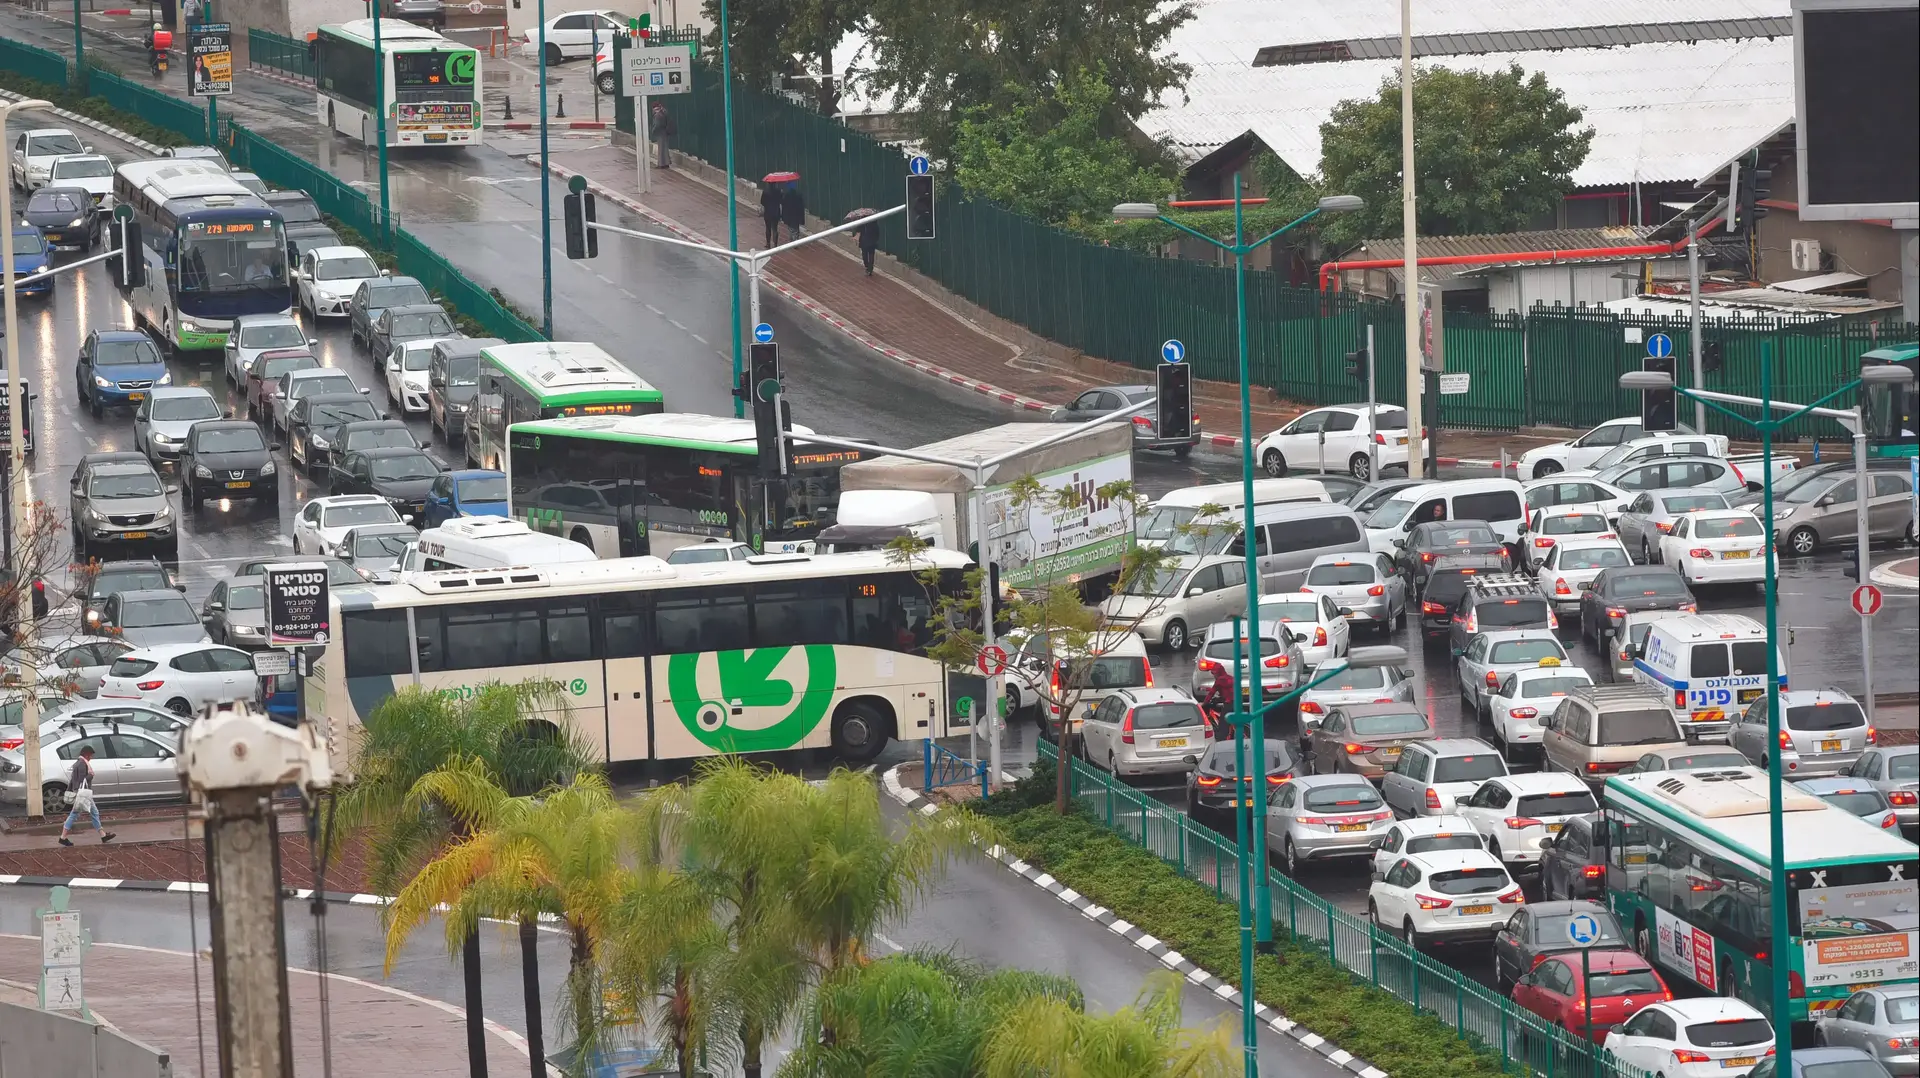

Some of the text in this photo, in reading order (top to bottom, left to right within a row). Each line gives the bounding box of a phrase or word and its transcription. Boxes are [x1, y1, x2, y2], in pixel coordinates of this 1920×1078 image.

[201, 36, 222, 45] הביתה
[630, 56, 681, 68] מיון בילינסון
[207, 224, 223, 234] 279
[430, 542, 446, 558] TOUR
[274, 573, 324, 585] סטריאו
[279, 585, 320, 597] סטאר
[297, 598, 317, 606] קולנוע
[274, 623, 319, 631] 03-924-10-10
[1706, 676, 1760, 688] אמבולנס
[1690, 689, 1732, 706] פיני
